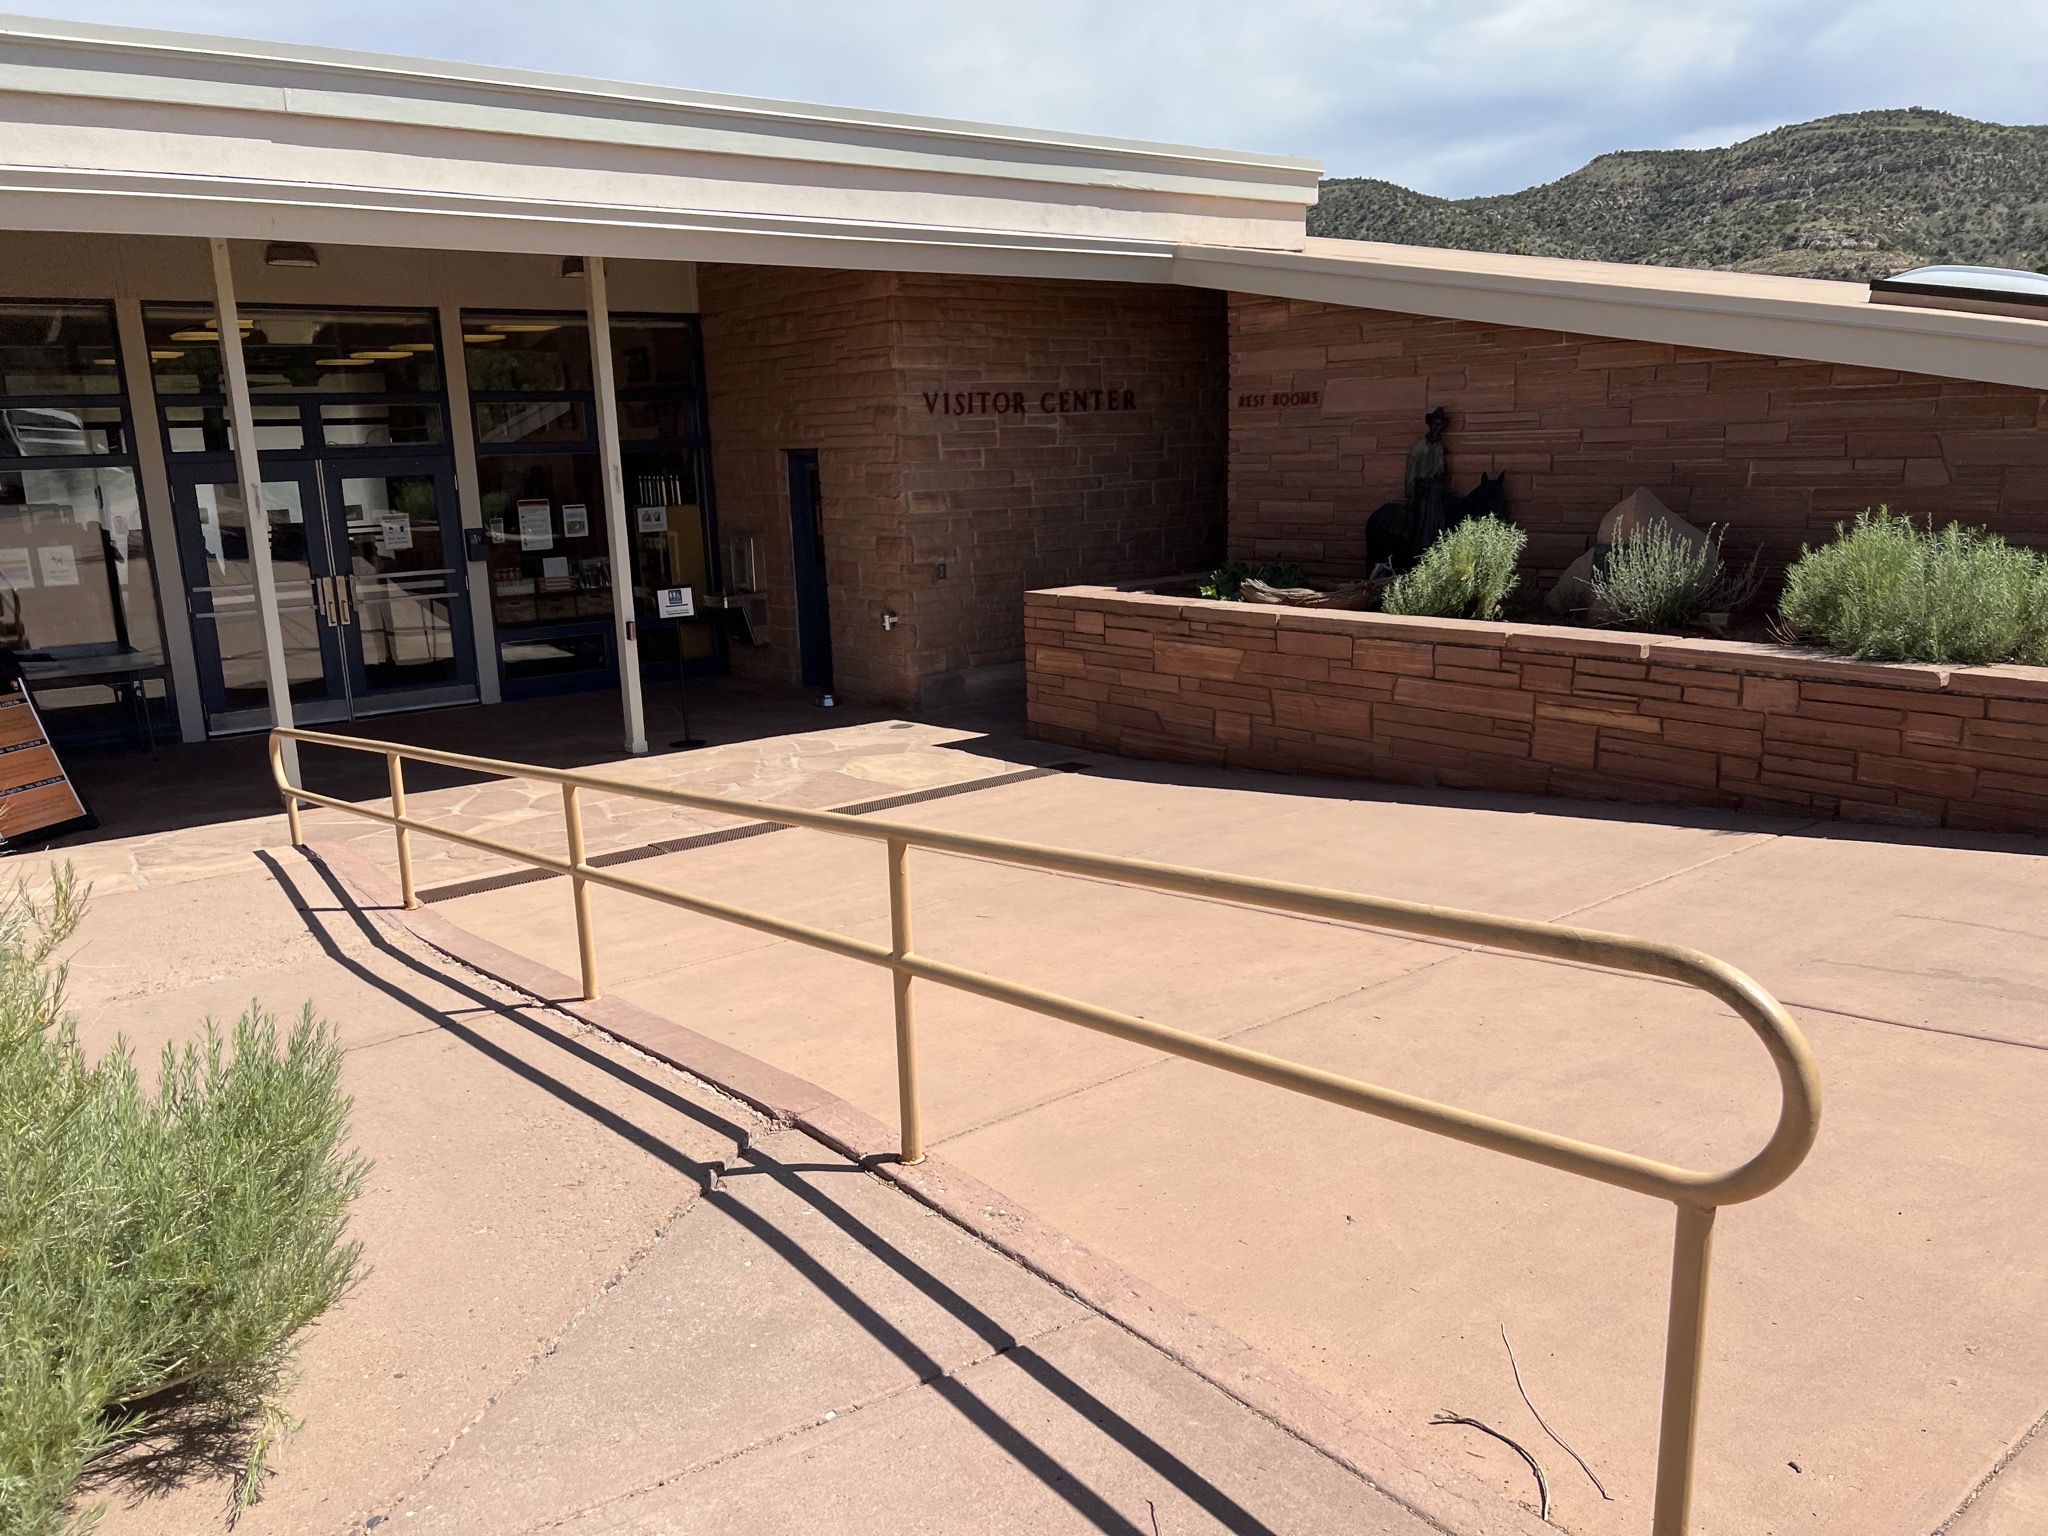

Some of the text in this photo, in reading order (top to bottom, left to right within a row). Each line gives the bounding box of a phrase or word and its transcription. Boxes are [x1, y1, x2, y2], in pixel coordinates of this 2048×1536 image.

[923, 389, 1136, 416] VISITOR CENTER
[1237, 391, 1320, 408] REST ROOMS
